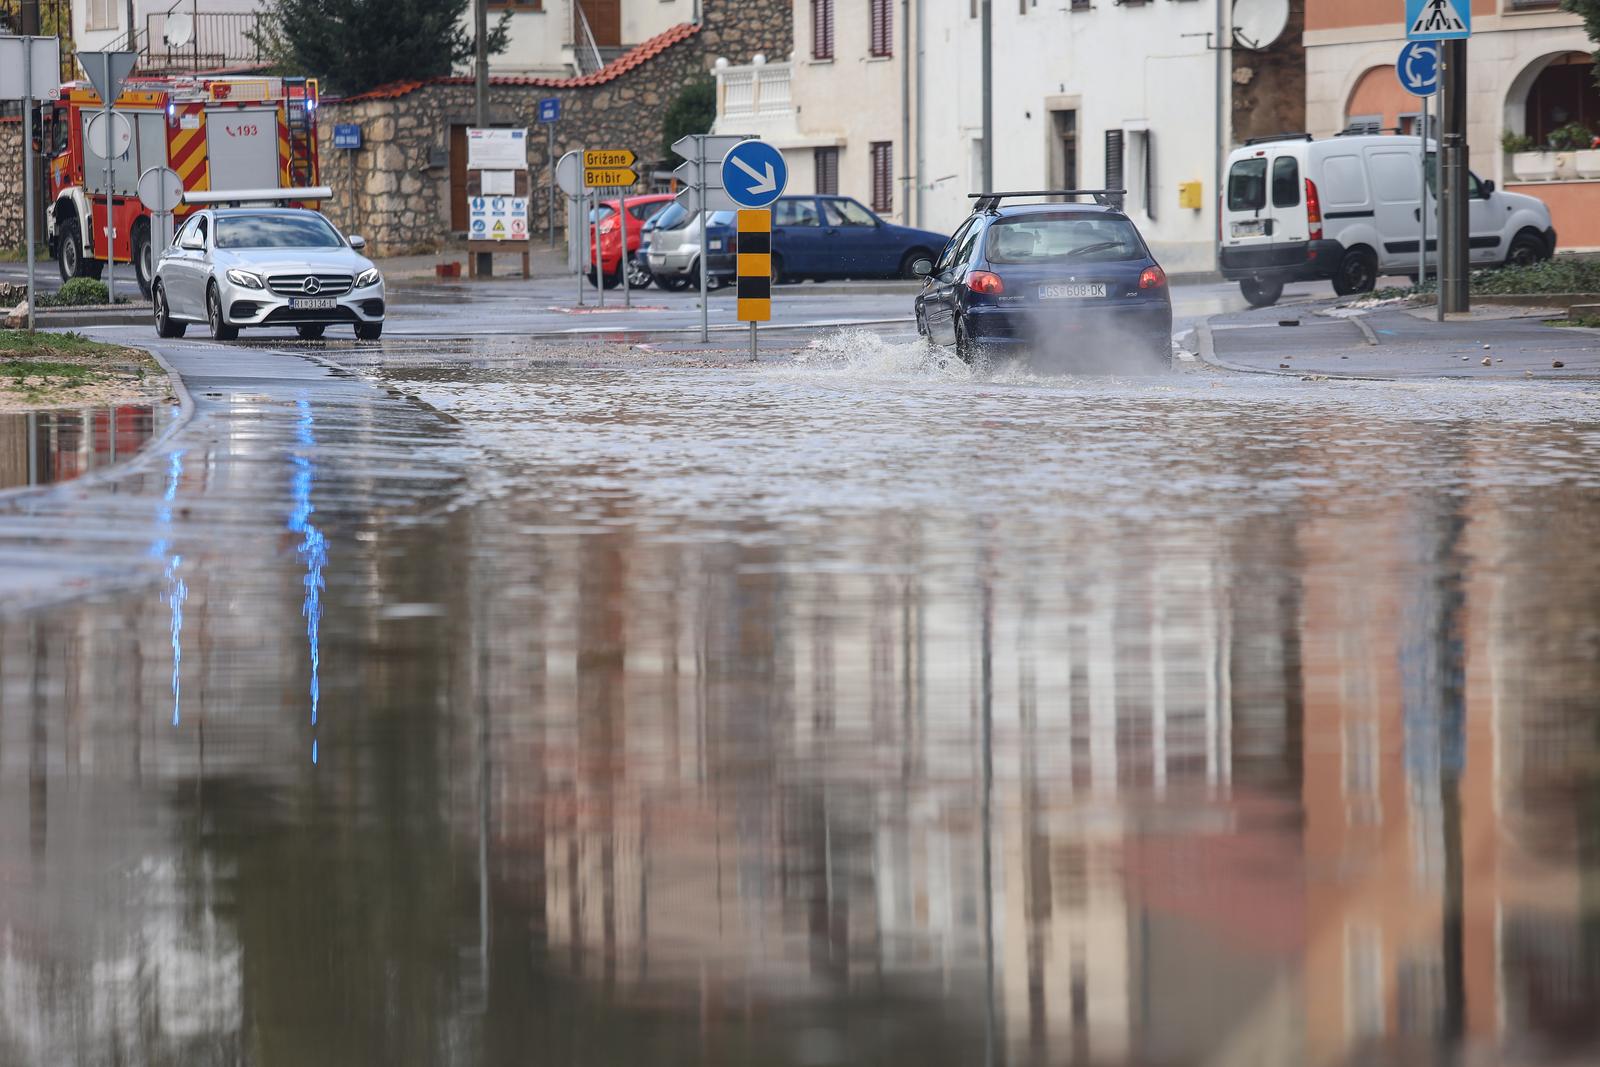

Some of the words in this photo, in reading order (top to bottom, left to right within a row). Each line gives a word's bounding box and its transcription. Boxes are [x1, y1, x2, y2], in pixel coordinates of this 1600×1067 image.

[237, 125, 257, 136] 193
[587, 153, 626, 165] Grižane
[587, 172, 621, 184] Bribir
[1047, 286, 1060, 297] GS
